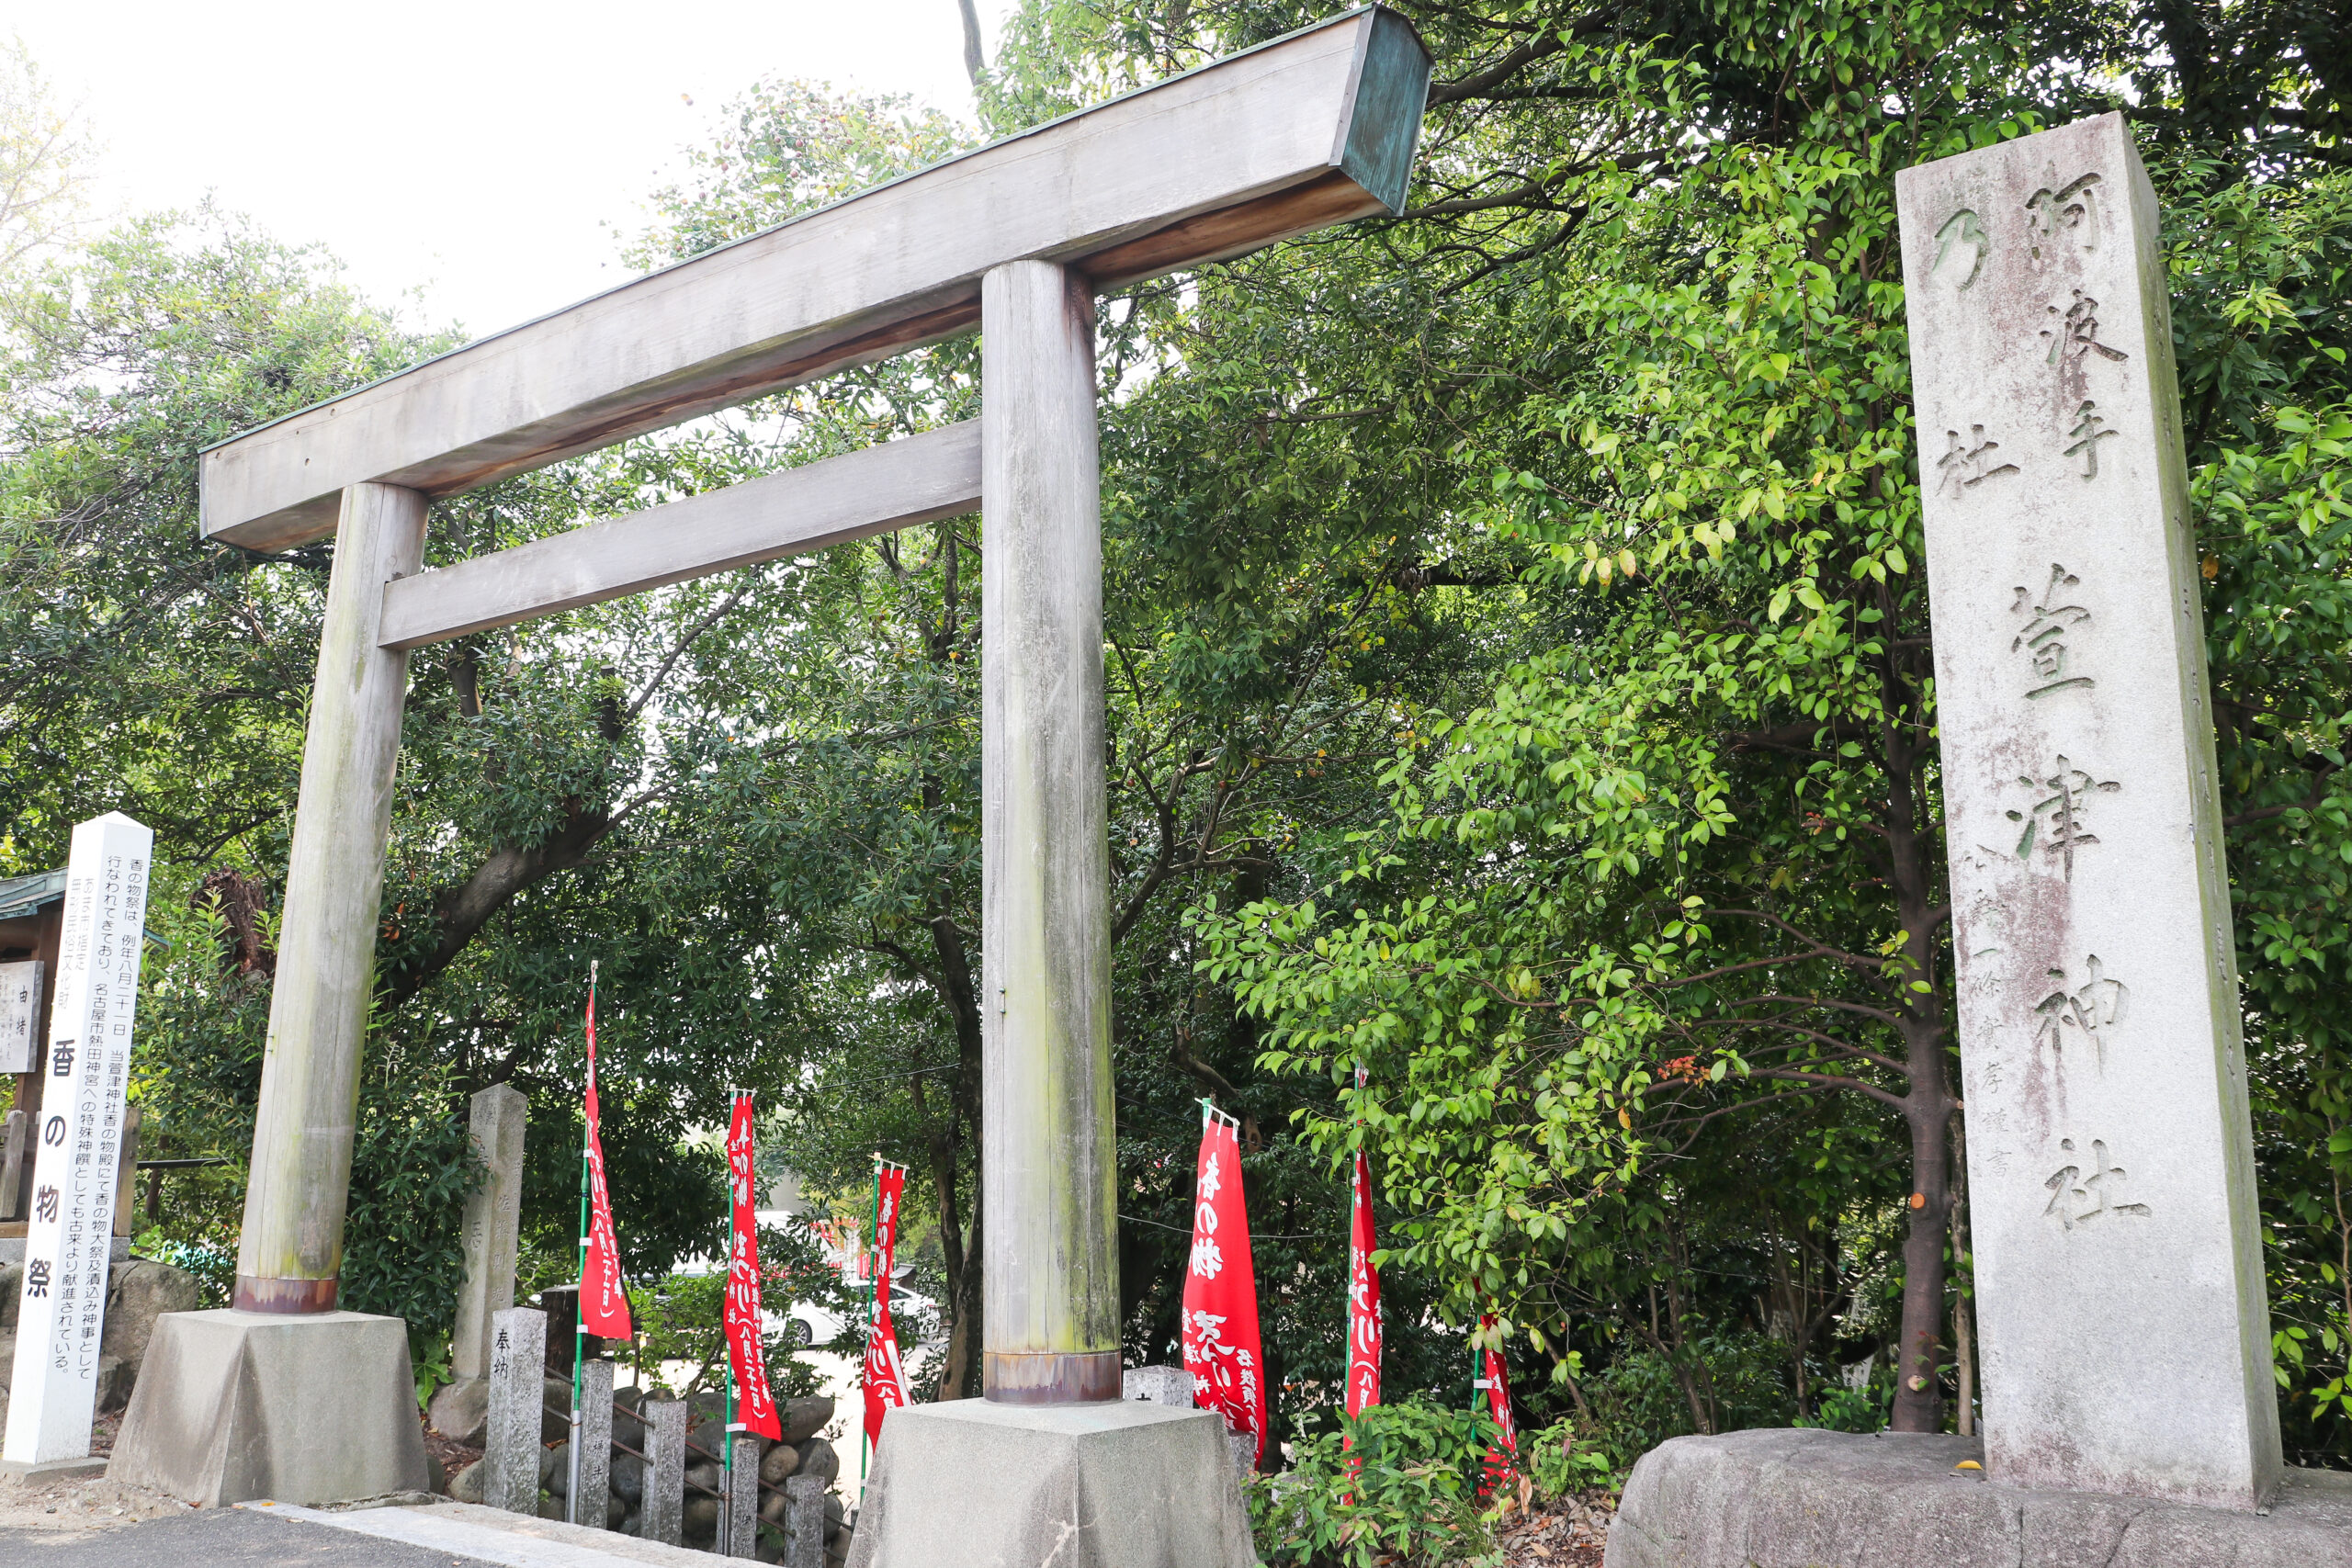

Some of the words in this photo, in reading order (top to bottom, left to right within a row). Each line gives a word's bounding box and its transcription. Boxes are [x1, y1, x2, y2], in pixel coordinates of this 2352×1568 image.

[2024, 171, 2129, 480] 阿波手
[2006, 562, 2152, 1232] 萱津神社
[28, 1039, 75, 1298] 香の物祭
[493, 1328, 510, 1380] 奉納
